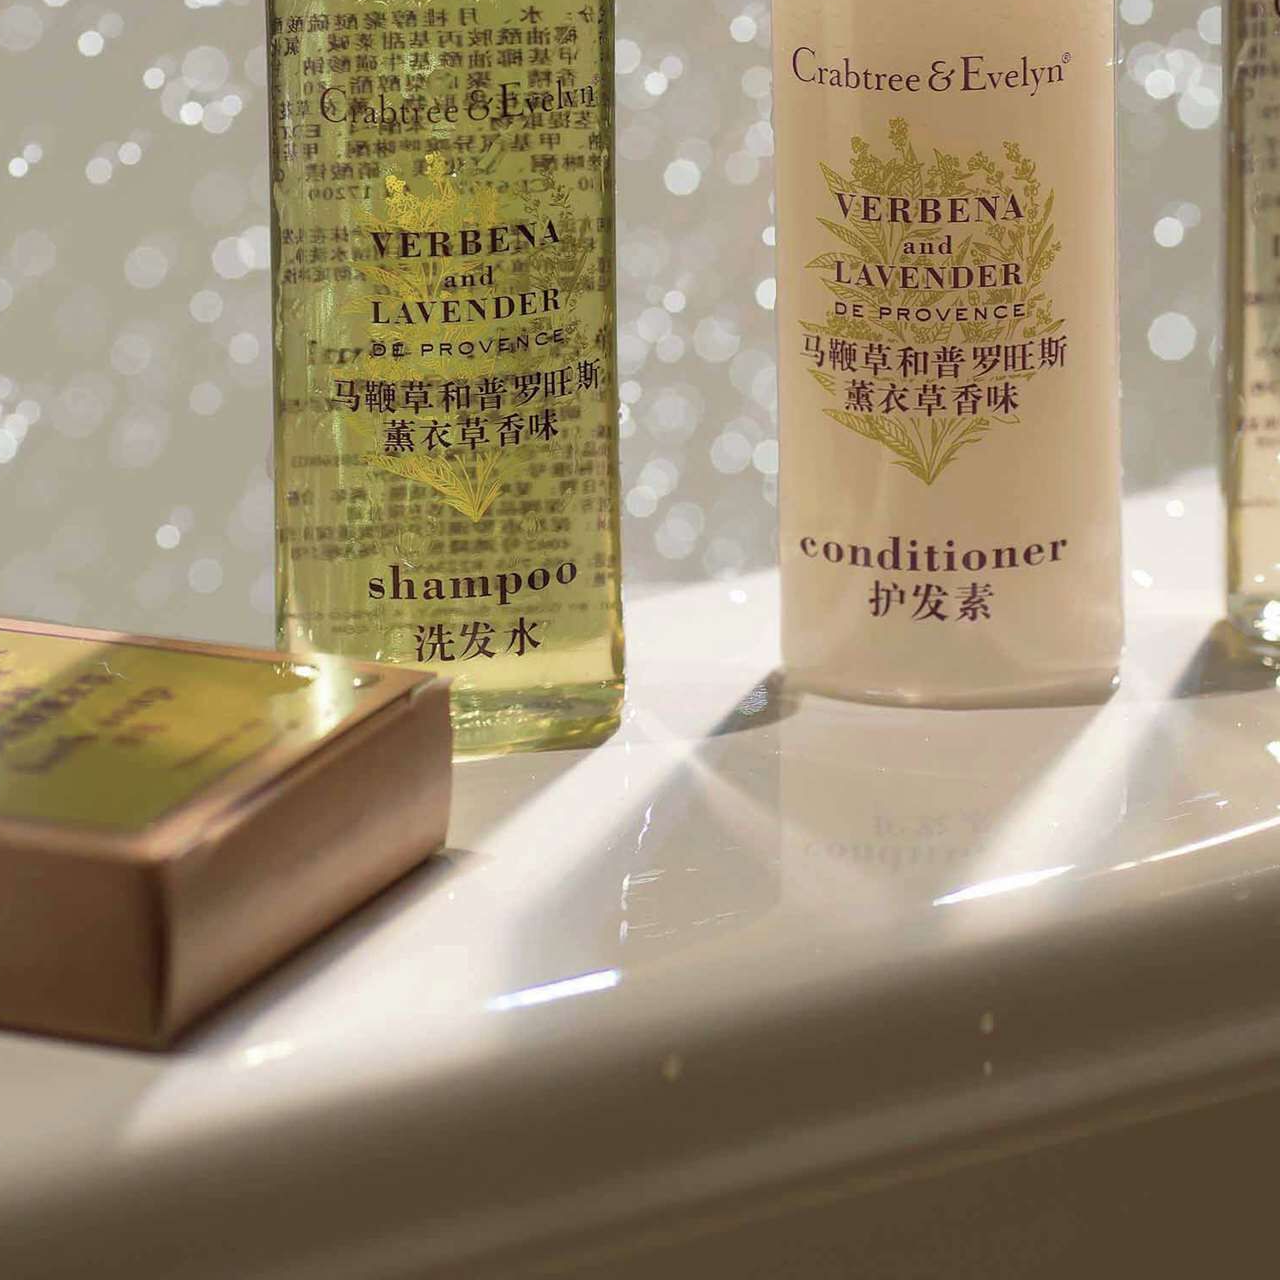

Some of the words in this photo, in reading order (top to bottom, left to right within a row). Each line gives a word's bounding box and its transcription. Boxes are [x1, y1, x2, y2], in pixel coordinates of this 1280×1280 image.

[792, 46, 920, 93] Crabtree
[928, 60, 955, 92] &
[320, 87, 459, 124] Crabtree
[469, 89, 493, 120] &
[833, 192, 1024, 225] VERBENA
[372, 220, 560, 258] VERBENA
[904, 235, 952, 255] and
[444, 267, 494, 289] and
[833, 261, 1024, 290] LAVENDER
[372, 288, 561, 325] LAVENDER
[834, 302, 864, 319] DE
[879, 303, 1025, 322] PROVENCE
[372, 340, 405, 357] DE
[421, 329, 564, 357] PROVENCE
[800, 333, 1068, 380] 马鞭草和普罗旺斯
[332, 360, 601, 415] 马鞭草和普罗旺斯
[845, 379, 1021, 417] 薰衣草香味
[383, 409, 560, 452] 薰衣草香味
[800, 536, 1068, 572] conditioner
[368, 562, 578, 606] shampoo
[868, 580, 995, 622] 护发素
[415, 617, 542, 663] 洗发水
